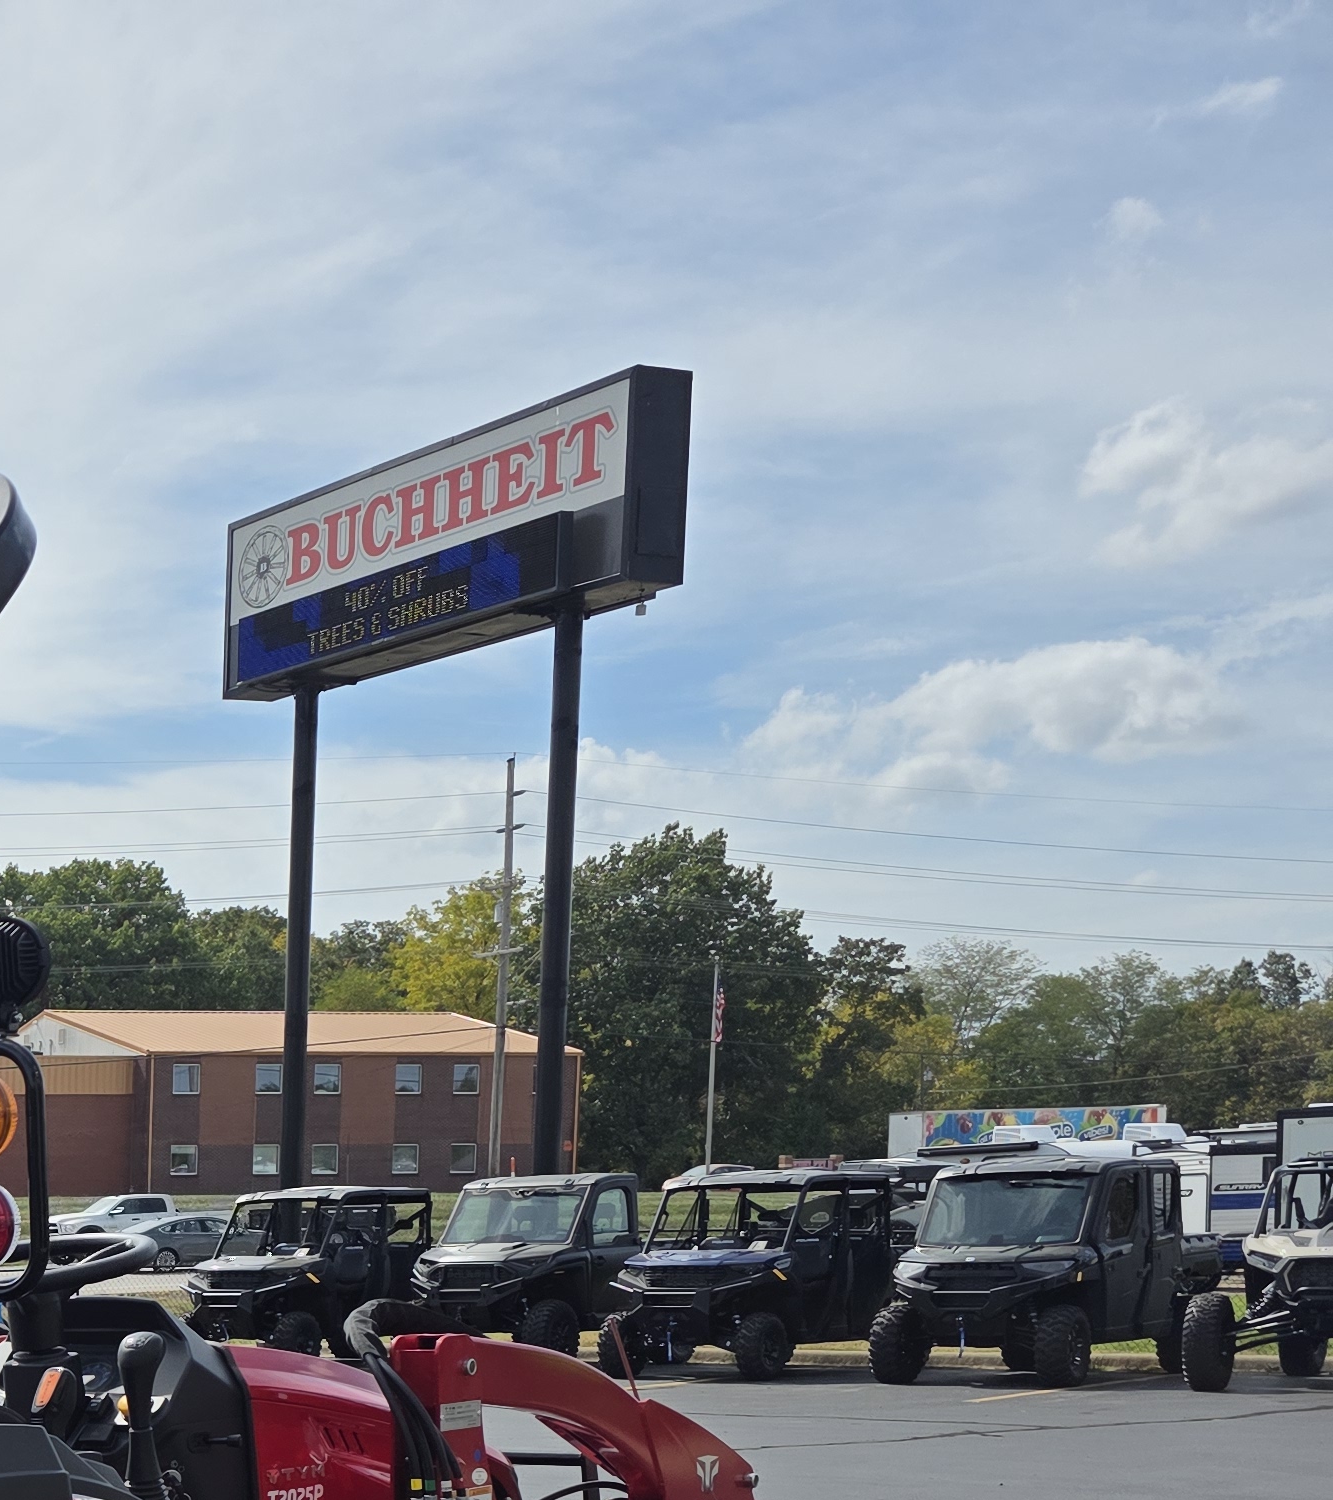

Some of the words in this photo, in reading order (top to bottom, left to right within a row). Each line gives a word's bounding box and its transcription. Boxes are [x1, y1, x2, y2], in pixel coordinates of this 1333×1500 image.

[286, 411, 616, 586] BUCHHEIT
[344, 579, 387, 613] 40%
[392, 565, 429, 599] OFF
[307, 617, 365, 655] TREES
[388, 584, 469, 631] SHRUBS
[1218, 1183, 1265, 1191] SUNRAY
[281, 1465, 326, 1481] TYM
